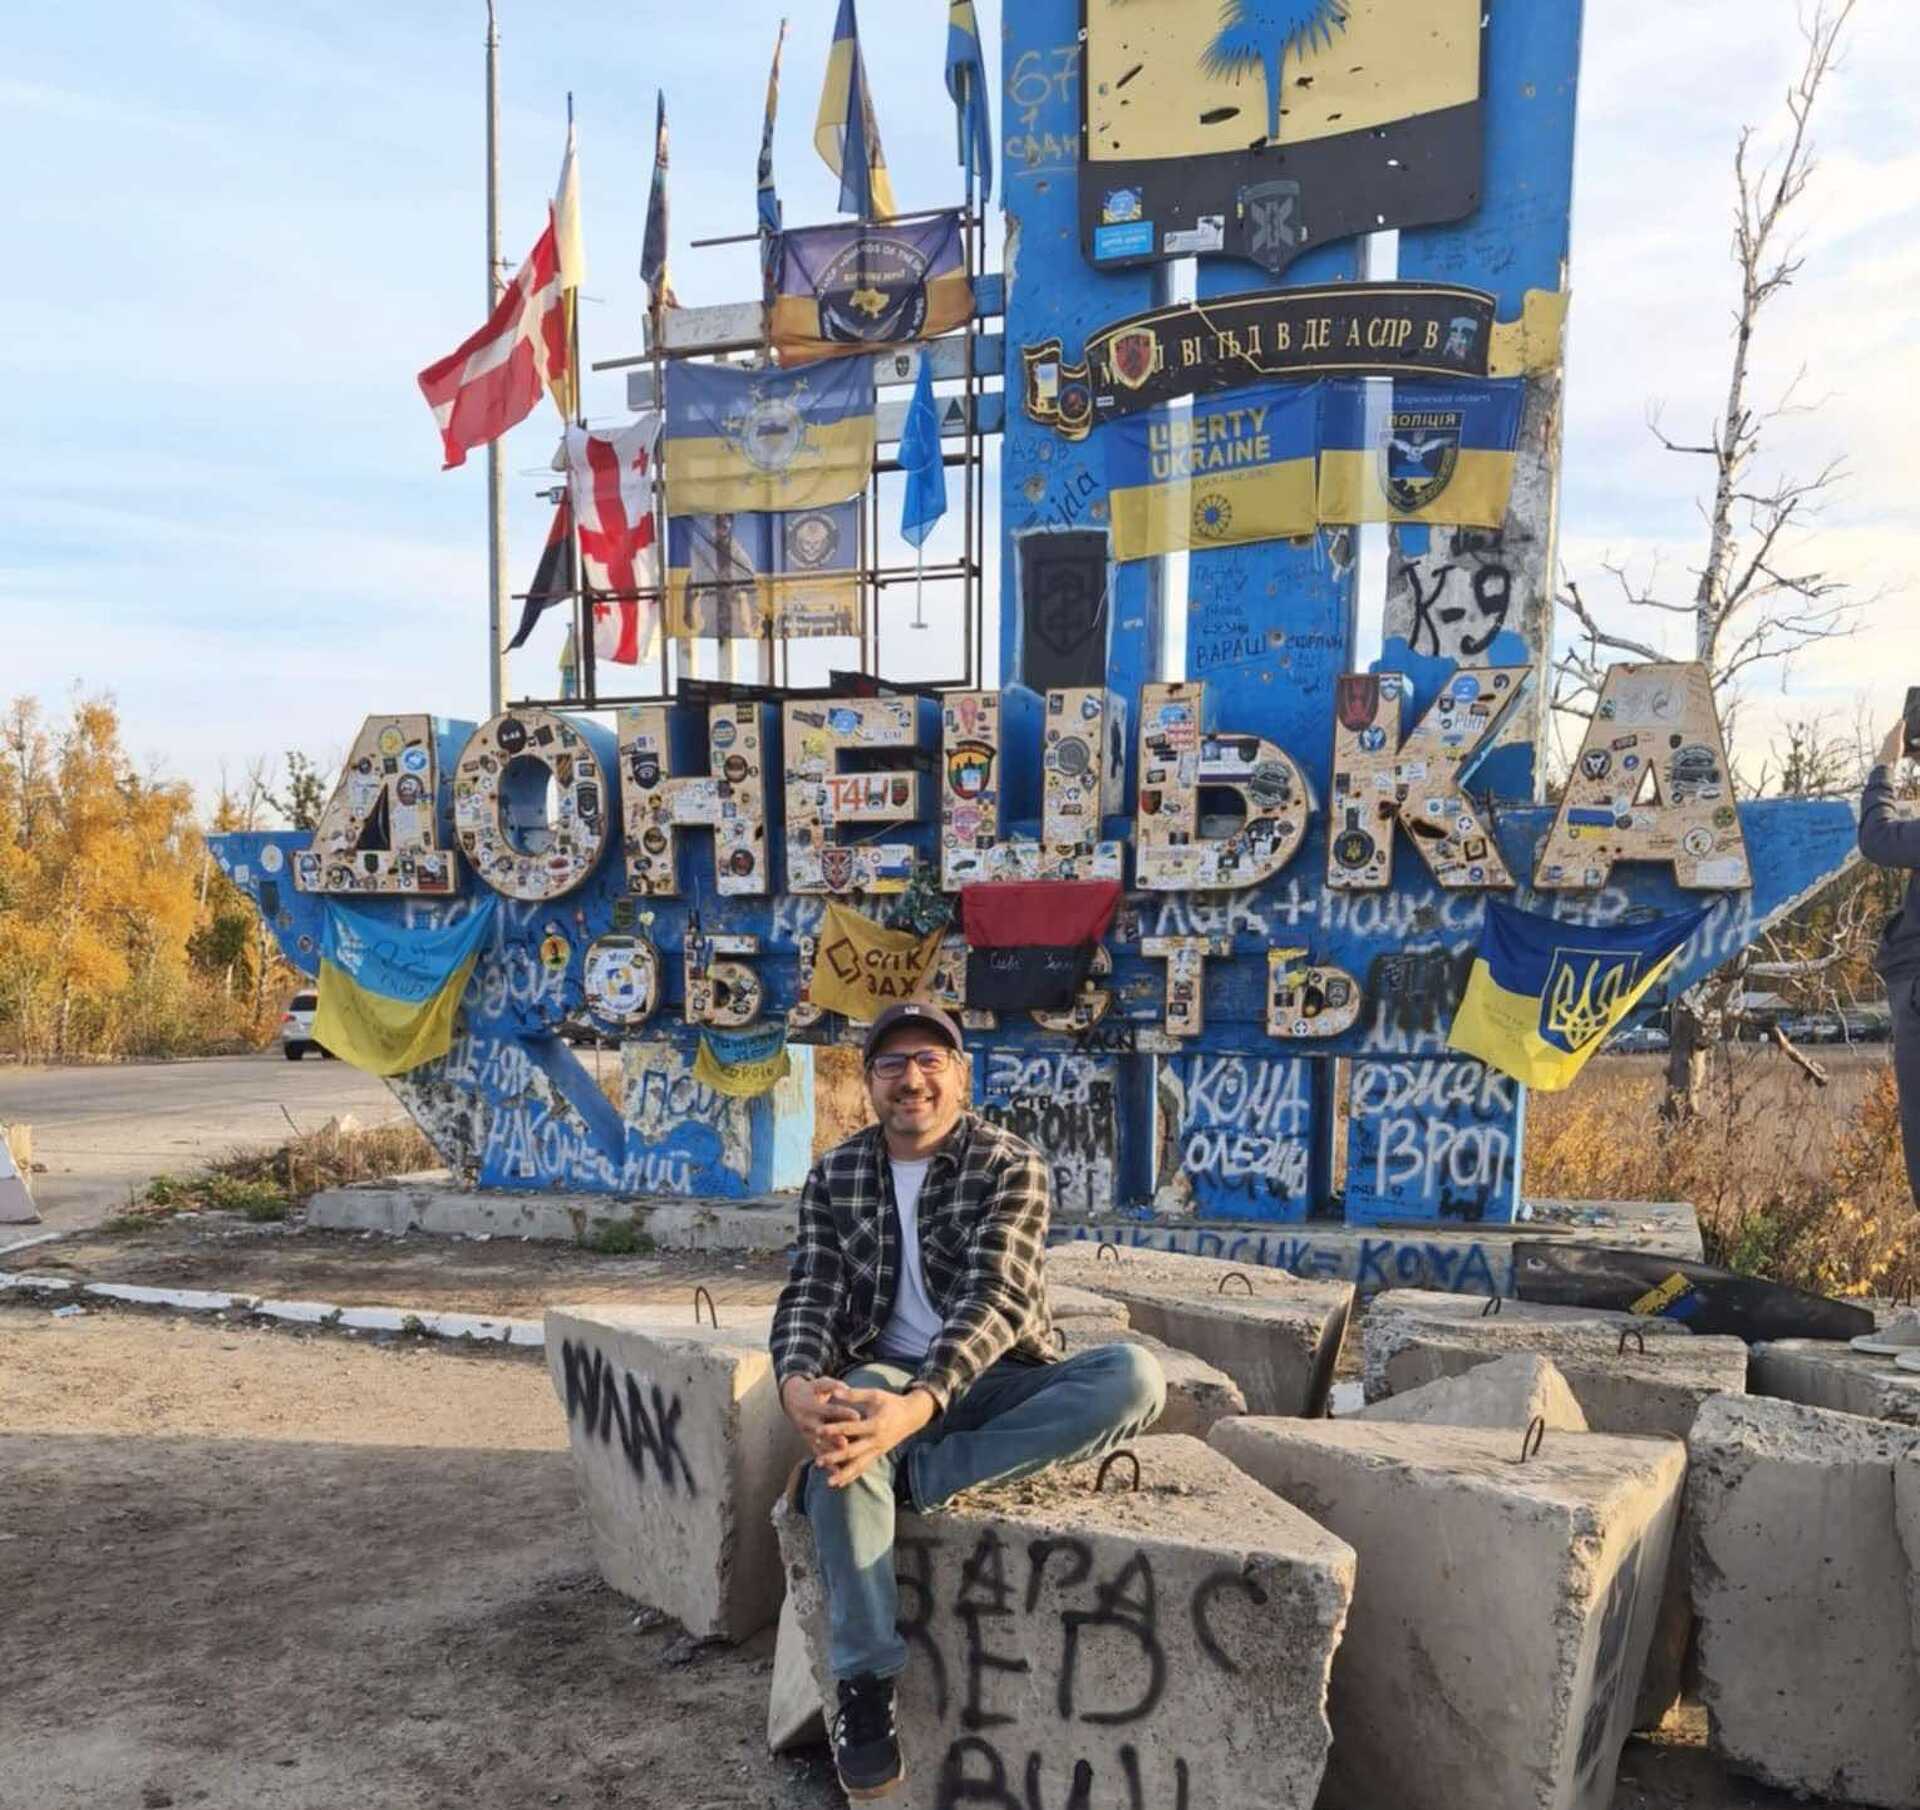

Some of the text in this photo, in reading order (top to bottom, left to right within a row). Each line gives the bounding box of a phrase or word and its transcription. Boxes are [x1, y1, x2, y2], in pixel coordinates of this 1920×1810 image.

[1148, 404, 1270, 452] LIBERTY
[1151, 434, 1271, 479] UKRAINE
[293, 660, 1753, 901] ДОНЕЦЬКА
[584, 933, 1361, 1039] ОБТЬ
